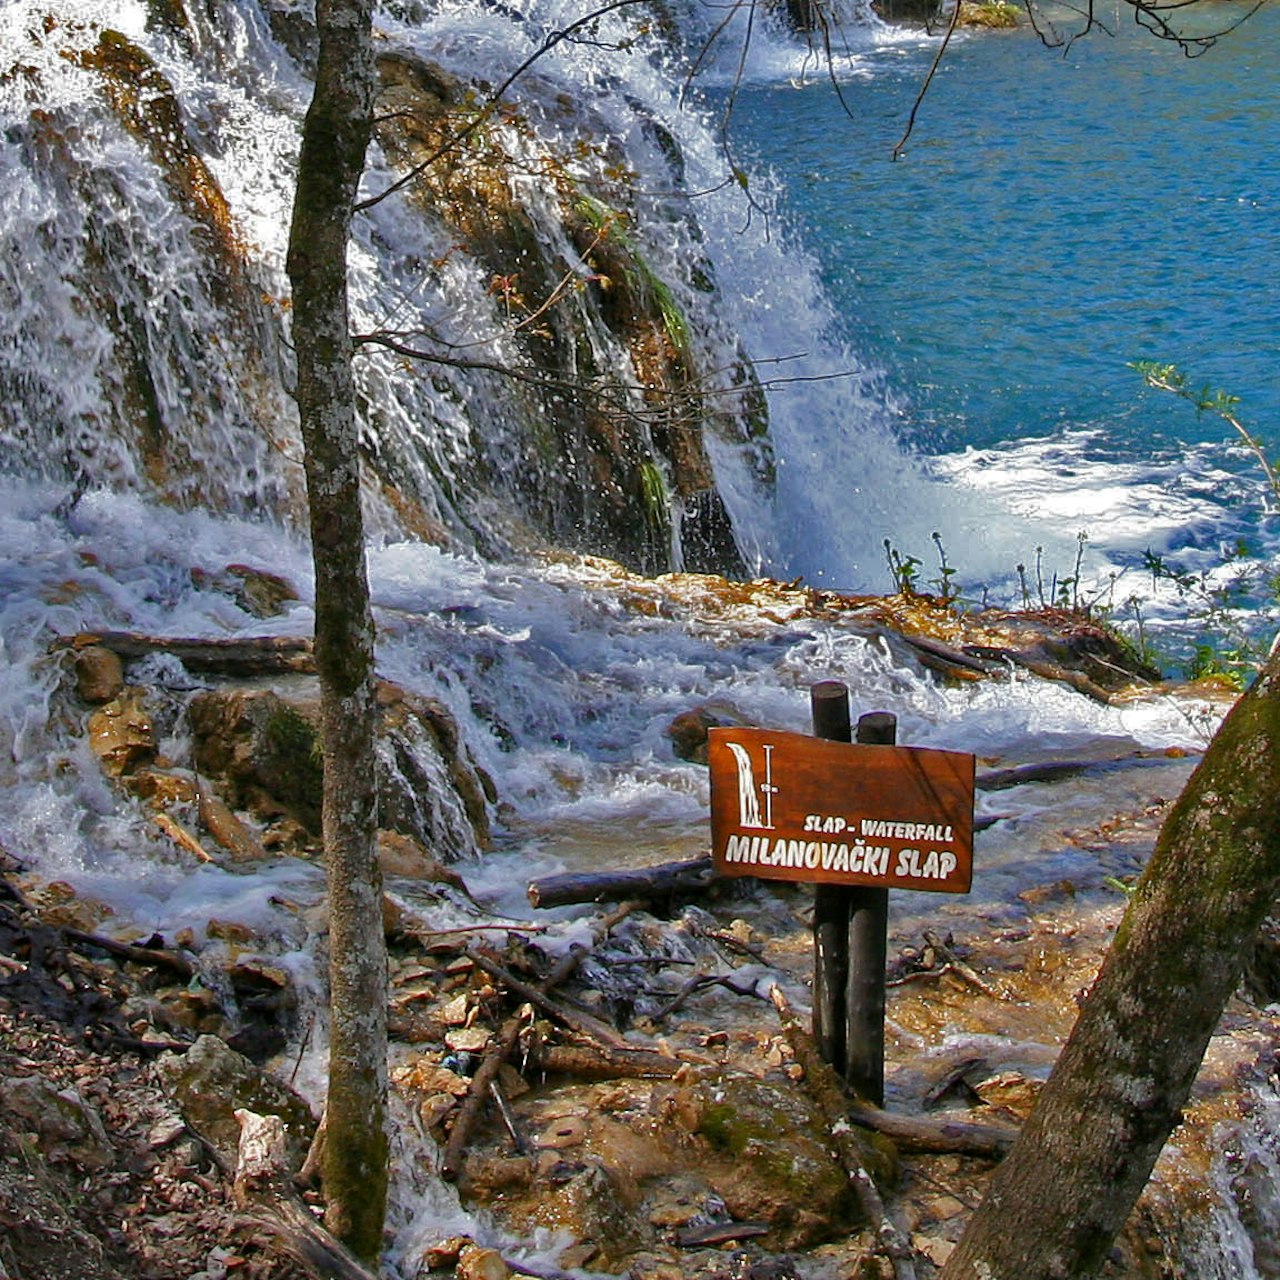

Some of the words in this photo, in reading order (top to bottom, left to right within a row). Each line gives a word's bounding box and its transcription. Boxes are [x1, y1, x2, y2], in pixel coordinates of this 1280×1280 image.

[804, 815, 846, 834] SLAP
[861, 819, 954, 842] WATERFALL
[726, 835, 890, 876] MILANOVAČKI
[895, 848, 958, 880] SLAP
